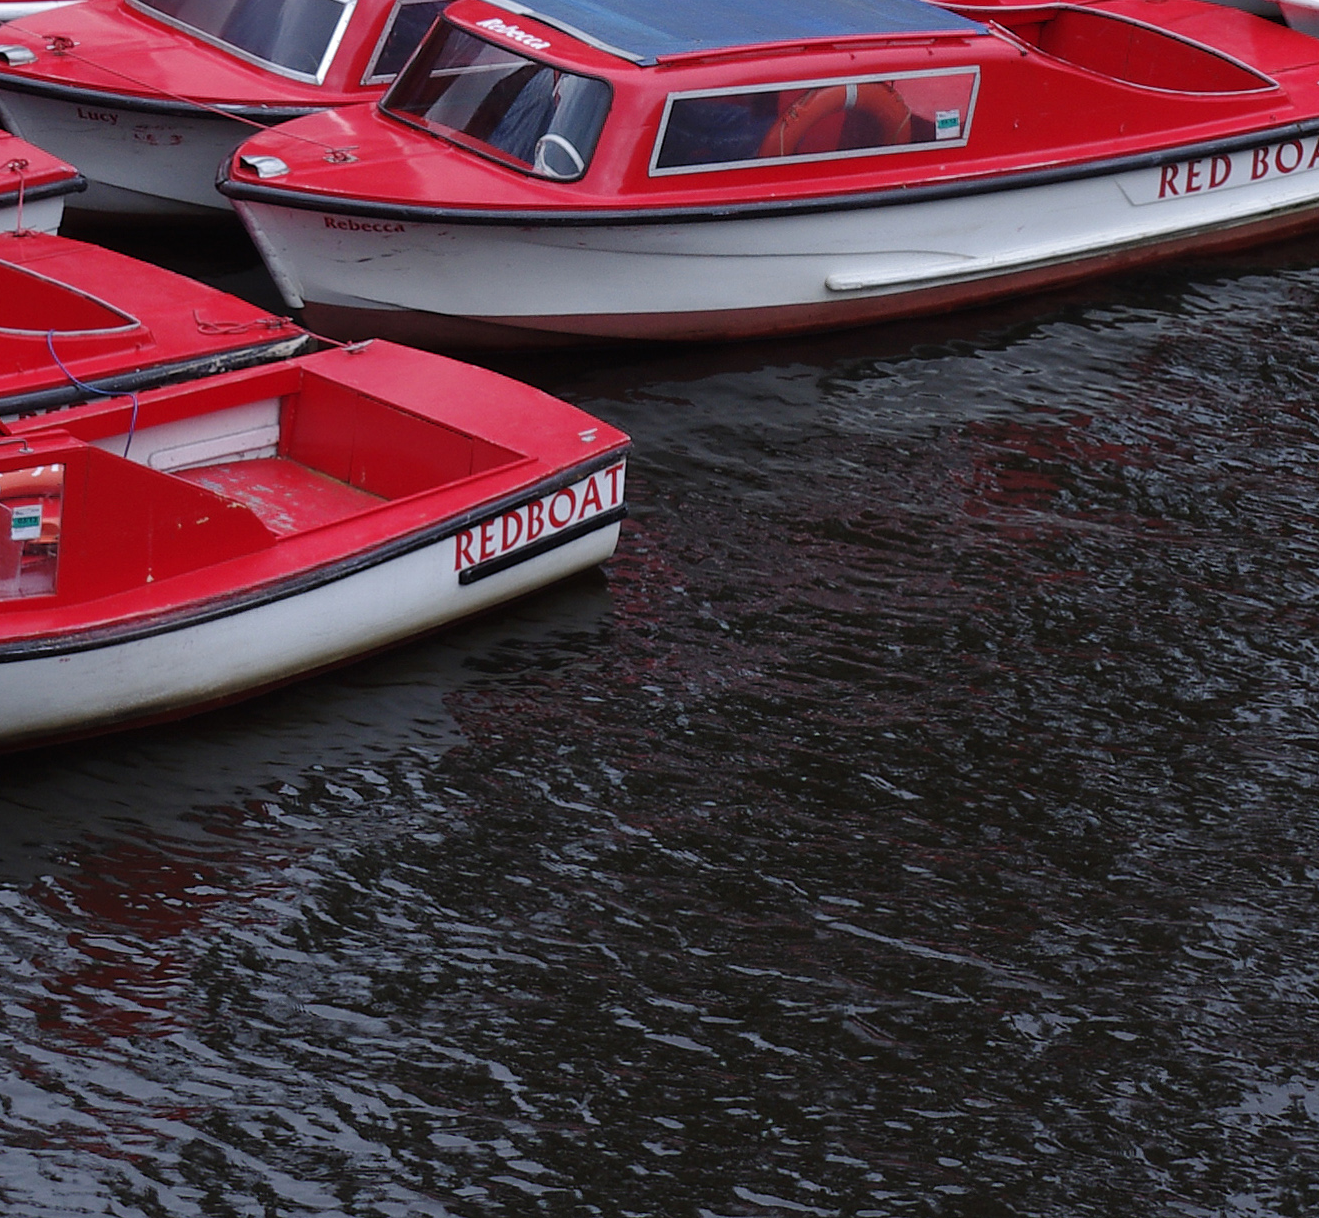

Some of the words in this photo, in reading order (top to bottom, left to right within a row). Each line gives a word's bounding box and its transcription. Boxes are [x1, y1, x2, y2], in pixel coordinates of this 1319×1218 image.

[475, 17, 552, 50] Rebecca
[77, 107, 119, 125] Lucy
[1158, 153, 1232, 198] RED
[324, 216, 406, 233] Rebecca
[454, 463, 624, 571] REDBOAT
